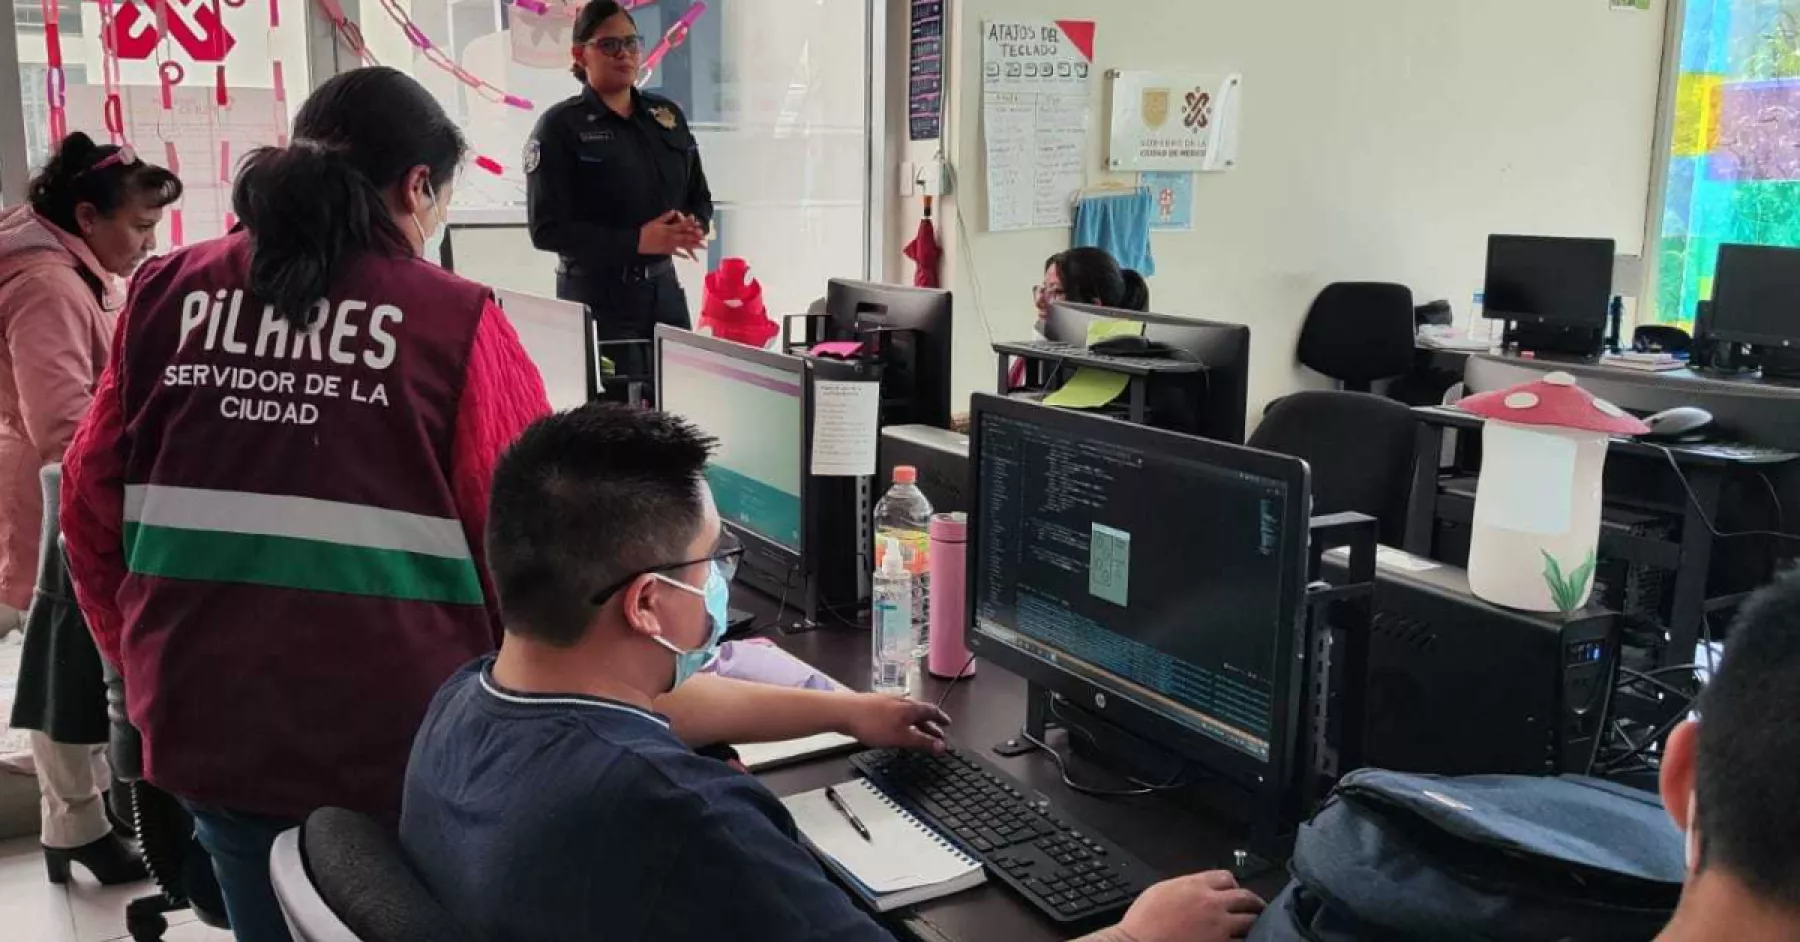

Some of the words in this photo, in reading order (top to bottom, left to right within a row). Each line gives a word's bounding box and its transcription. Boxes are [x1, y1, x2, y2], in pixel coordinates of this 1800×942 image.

[988, 23, 1036, 41] ATAJOS
[1040, 26, 1060, 42] DEL
[999, 43, 1057, 57] TECLADO
[163, 364, 296, 394] SERVIDOR
[304, 373, 342, 397] DE
[350, 379, 389, 407] LA
[220, 396, 319, 424] CIUDAD
